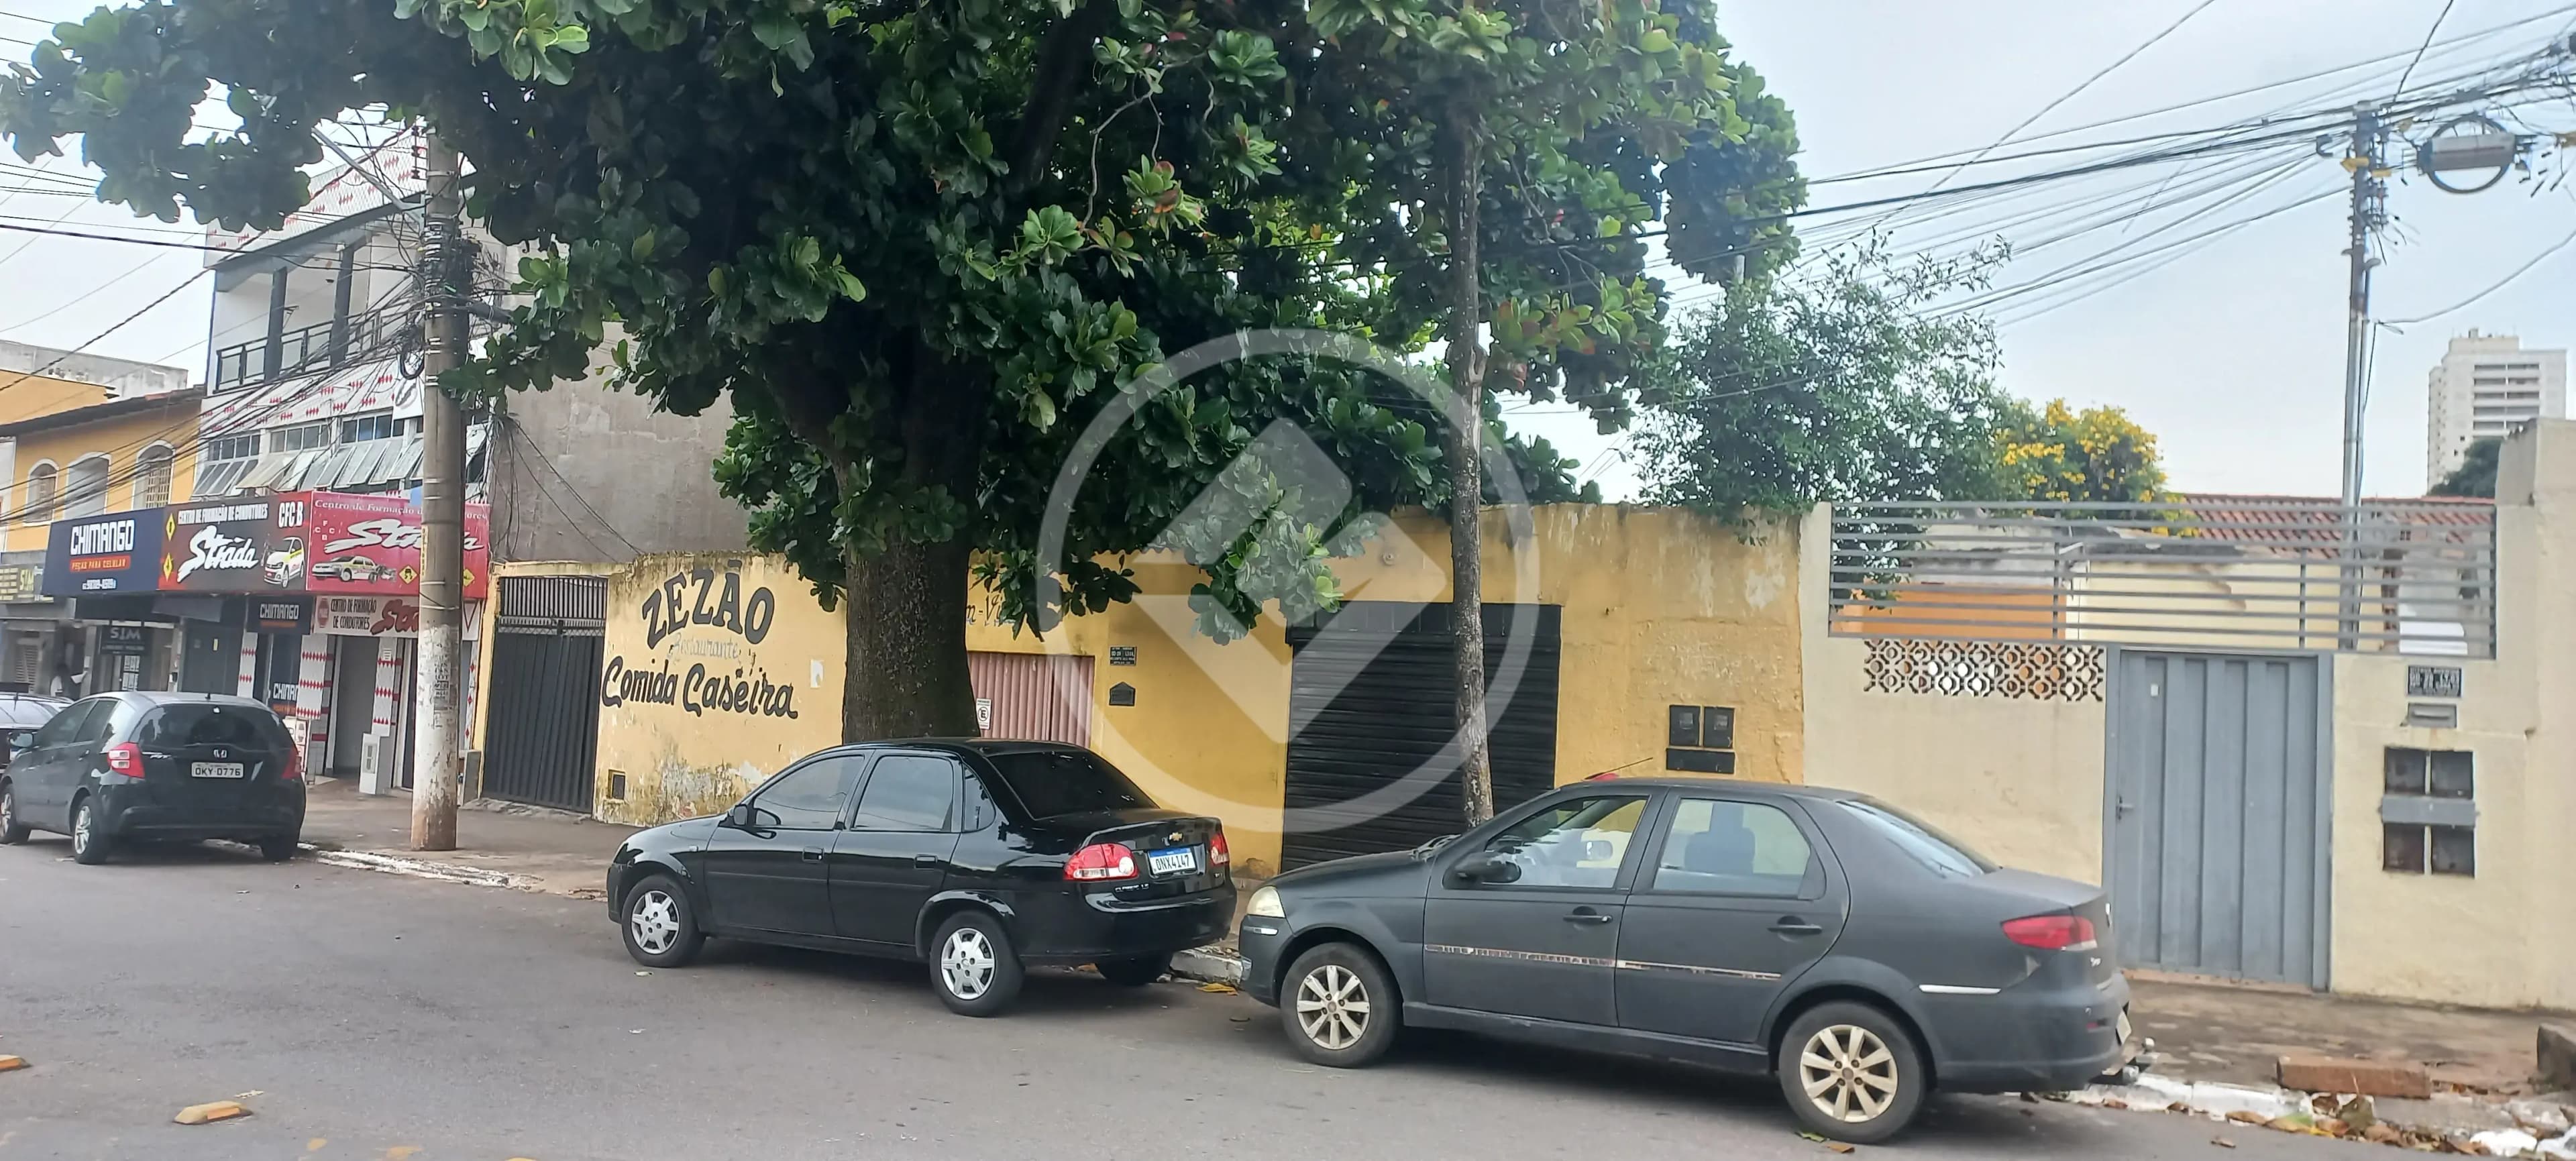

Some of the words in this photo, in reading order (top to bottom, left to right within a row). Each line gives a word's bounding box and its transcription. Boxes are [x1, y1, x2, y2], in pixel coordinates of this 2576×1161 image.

[278, 501, 296, 528] CFC
[315, 499, 350, 510] Centro
[351, 501, 364, 511] de
[367, 504, 417, 516] Formação
[70, 519, 135, 555] CHIMANGO
[177, 524, 259, 583] Strada
[260, 603, 299, 620] CHIMANGO
[642, 559, 775, 649] ZEZÃO
[110, 626, 141, 641] SIM
[668, 632, 739, 660] Restaurante
[601, 655, 675, 708] Comida
[682, 663, 798, 719] Caseira
